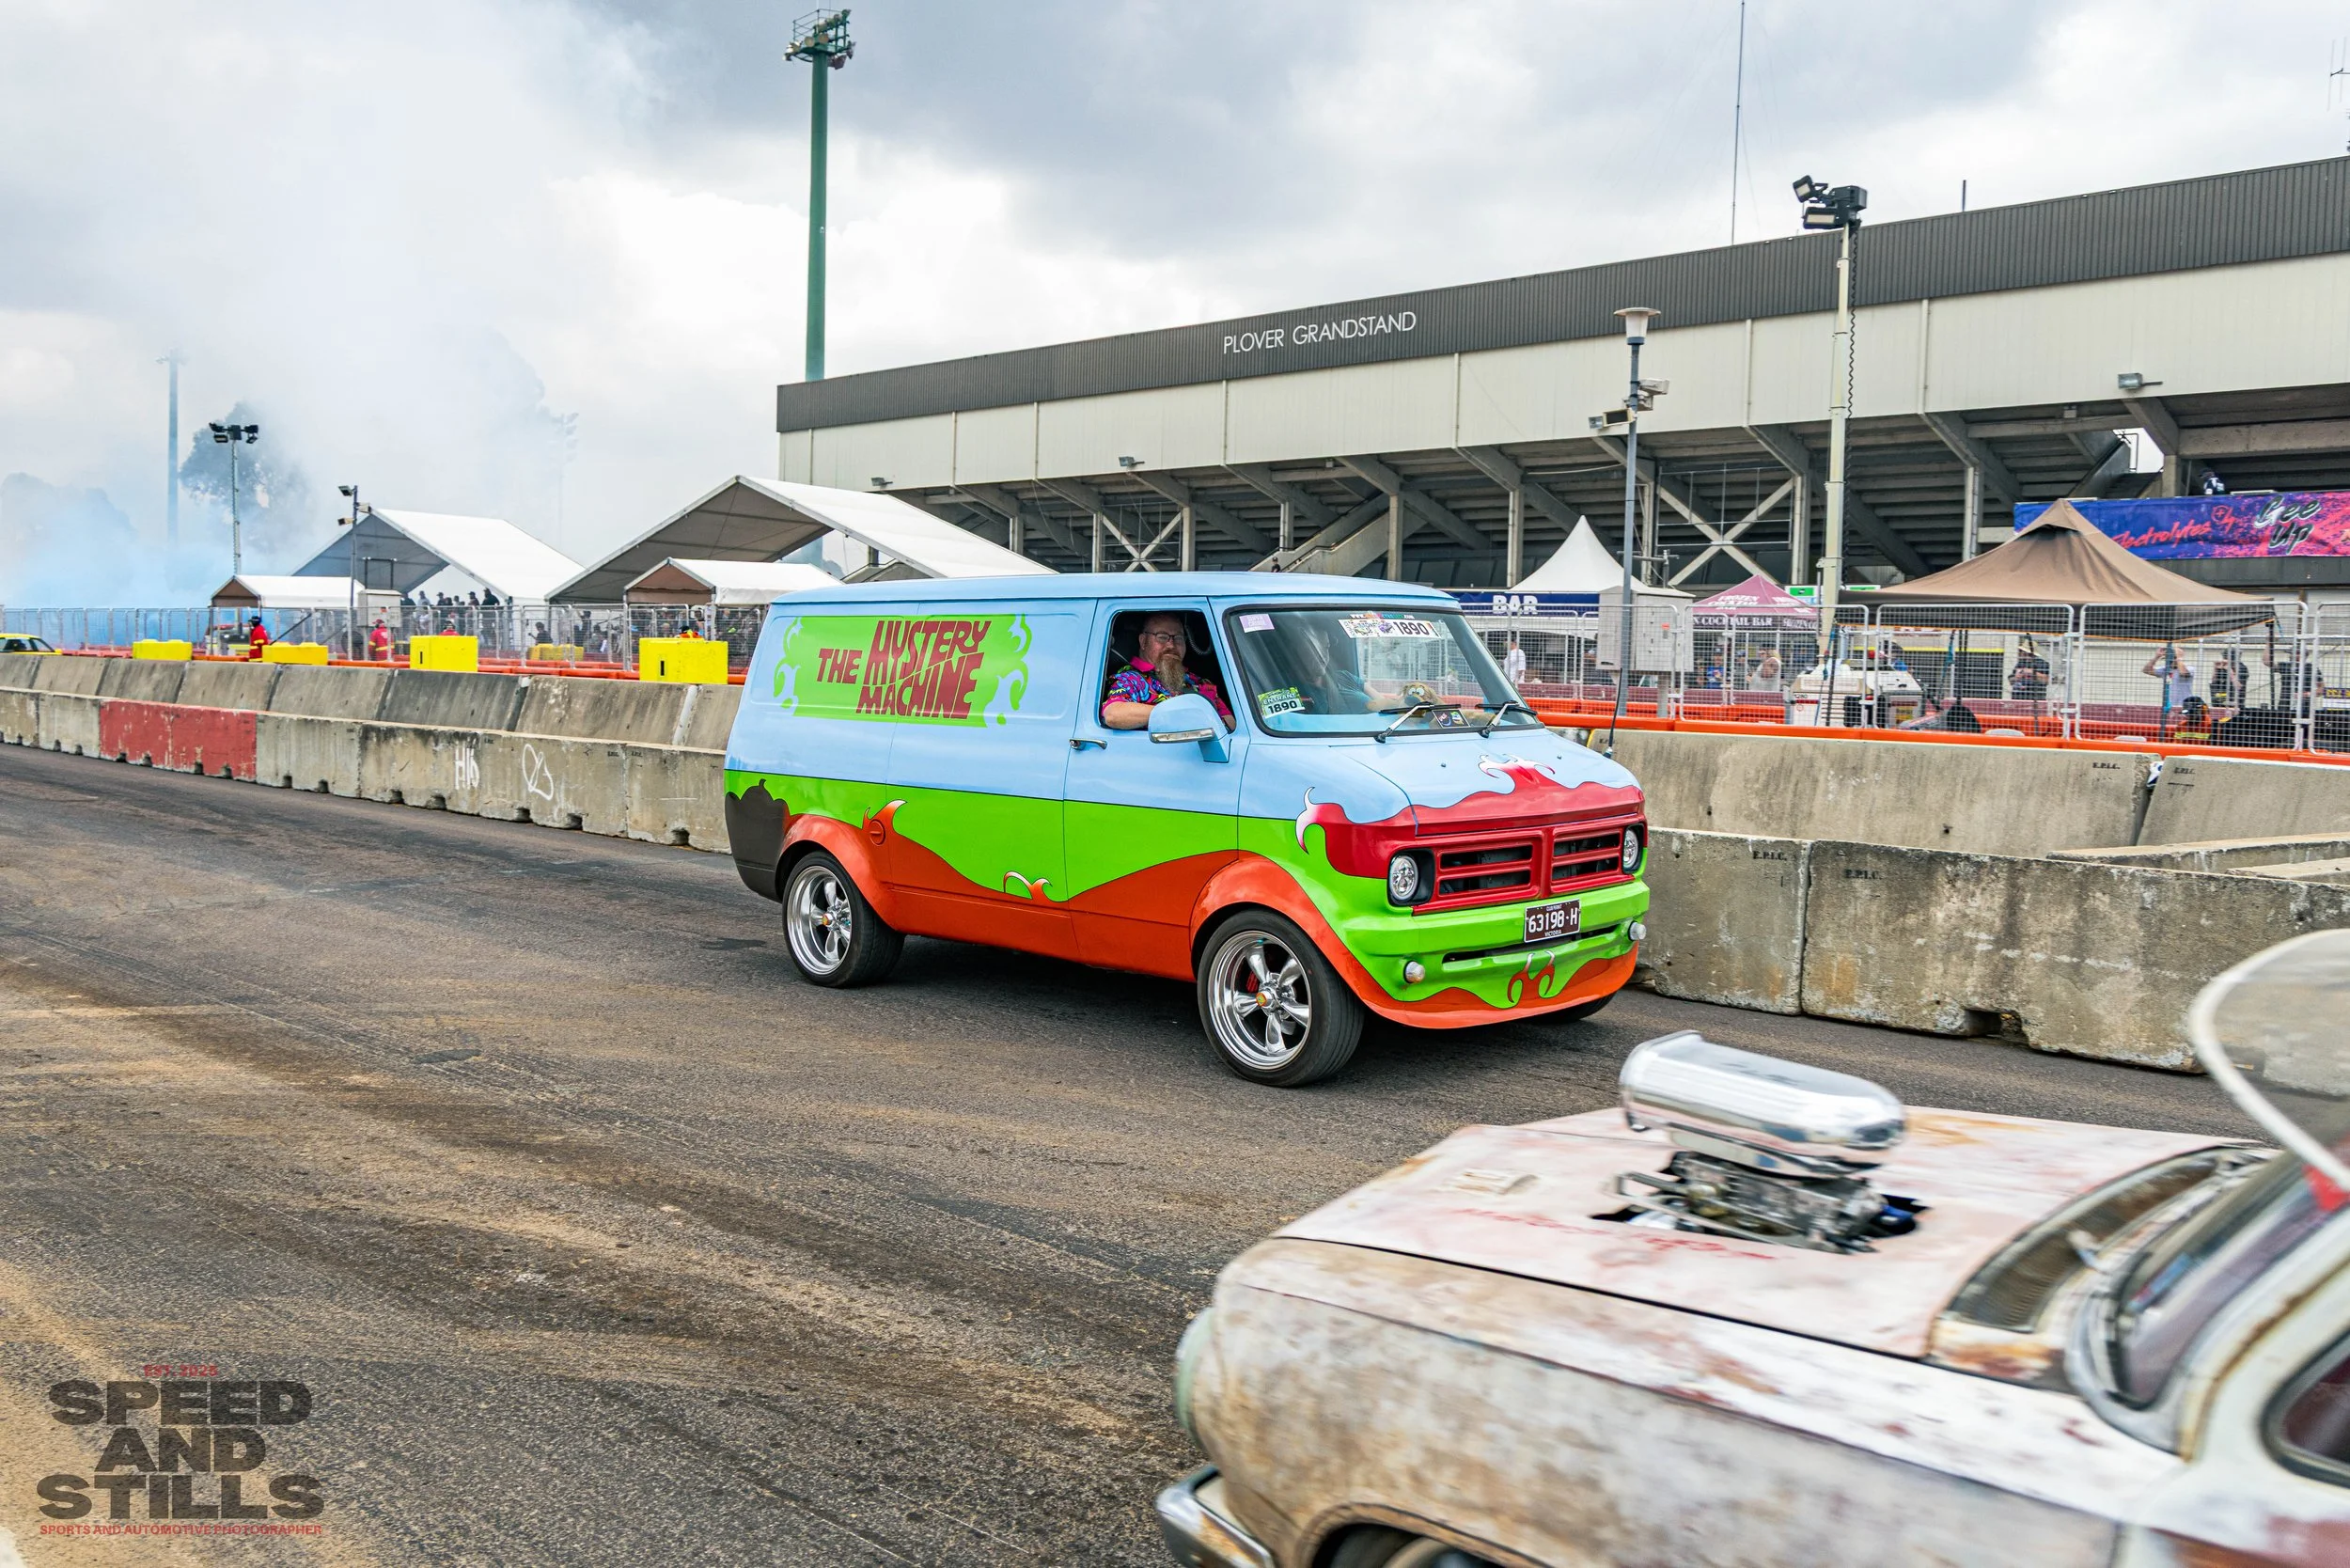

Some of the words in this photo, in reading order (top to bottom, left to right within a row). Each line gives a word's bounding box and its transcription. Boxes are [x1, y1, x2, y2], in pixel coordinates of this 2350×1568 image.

[1223, 329, 1285, 354] PLOVER
[1292, 311, 1417, 345] GRANDSTAND
[2254, 495, 2322, 528] Gee
[2268, 522, 2315, 556] Up
[1493, 595, 1539, 615] BAR
[1751, 617, 1773, 626] BAR
[1392, 621, 1430, 635] 1890
[816, 648, 863, 684] THE
[863, 620, 992, 685] MYSTERY
[855, 652, 984, 719] MACHINE
[1268, 700, 1297, 713] 1890
